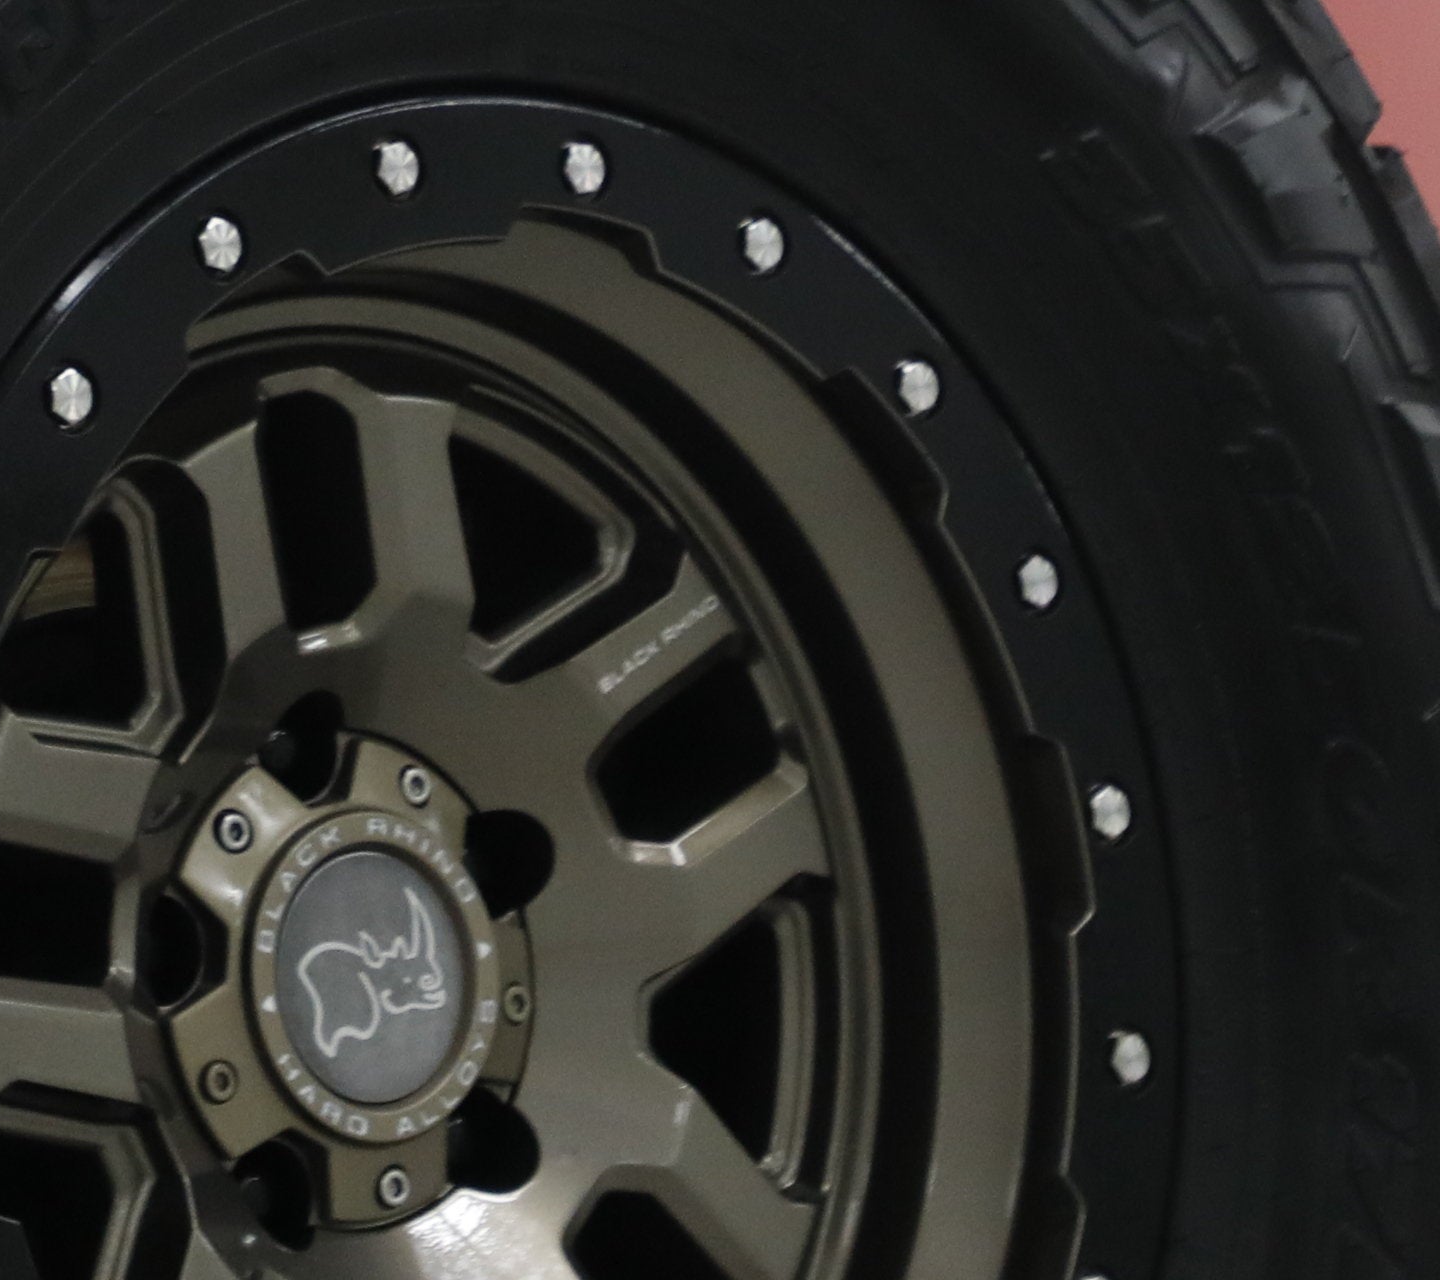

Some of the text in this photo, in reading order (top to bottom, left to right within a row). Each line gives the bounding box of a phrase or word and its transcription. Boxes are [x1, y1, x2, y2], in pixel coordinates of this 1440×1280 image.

[597, 594, 720, 694] BLACK RHINO
[256, 811, 476, 953] BLACK RHINO
[277, 1053, 369, 1136] HARD
